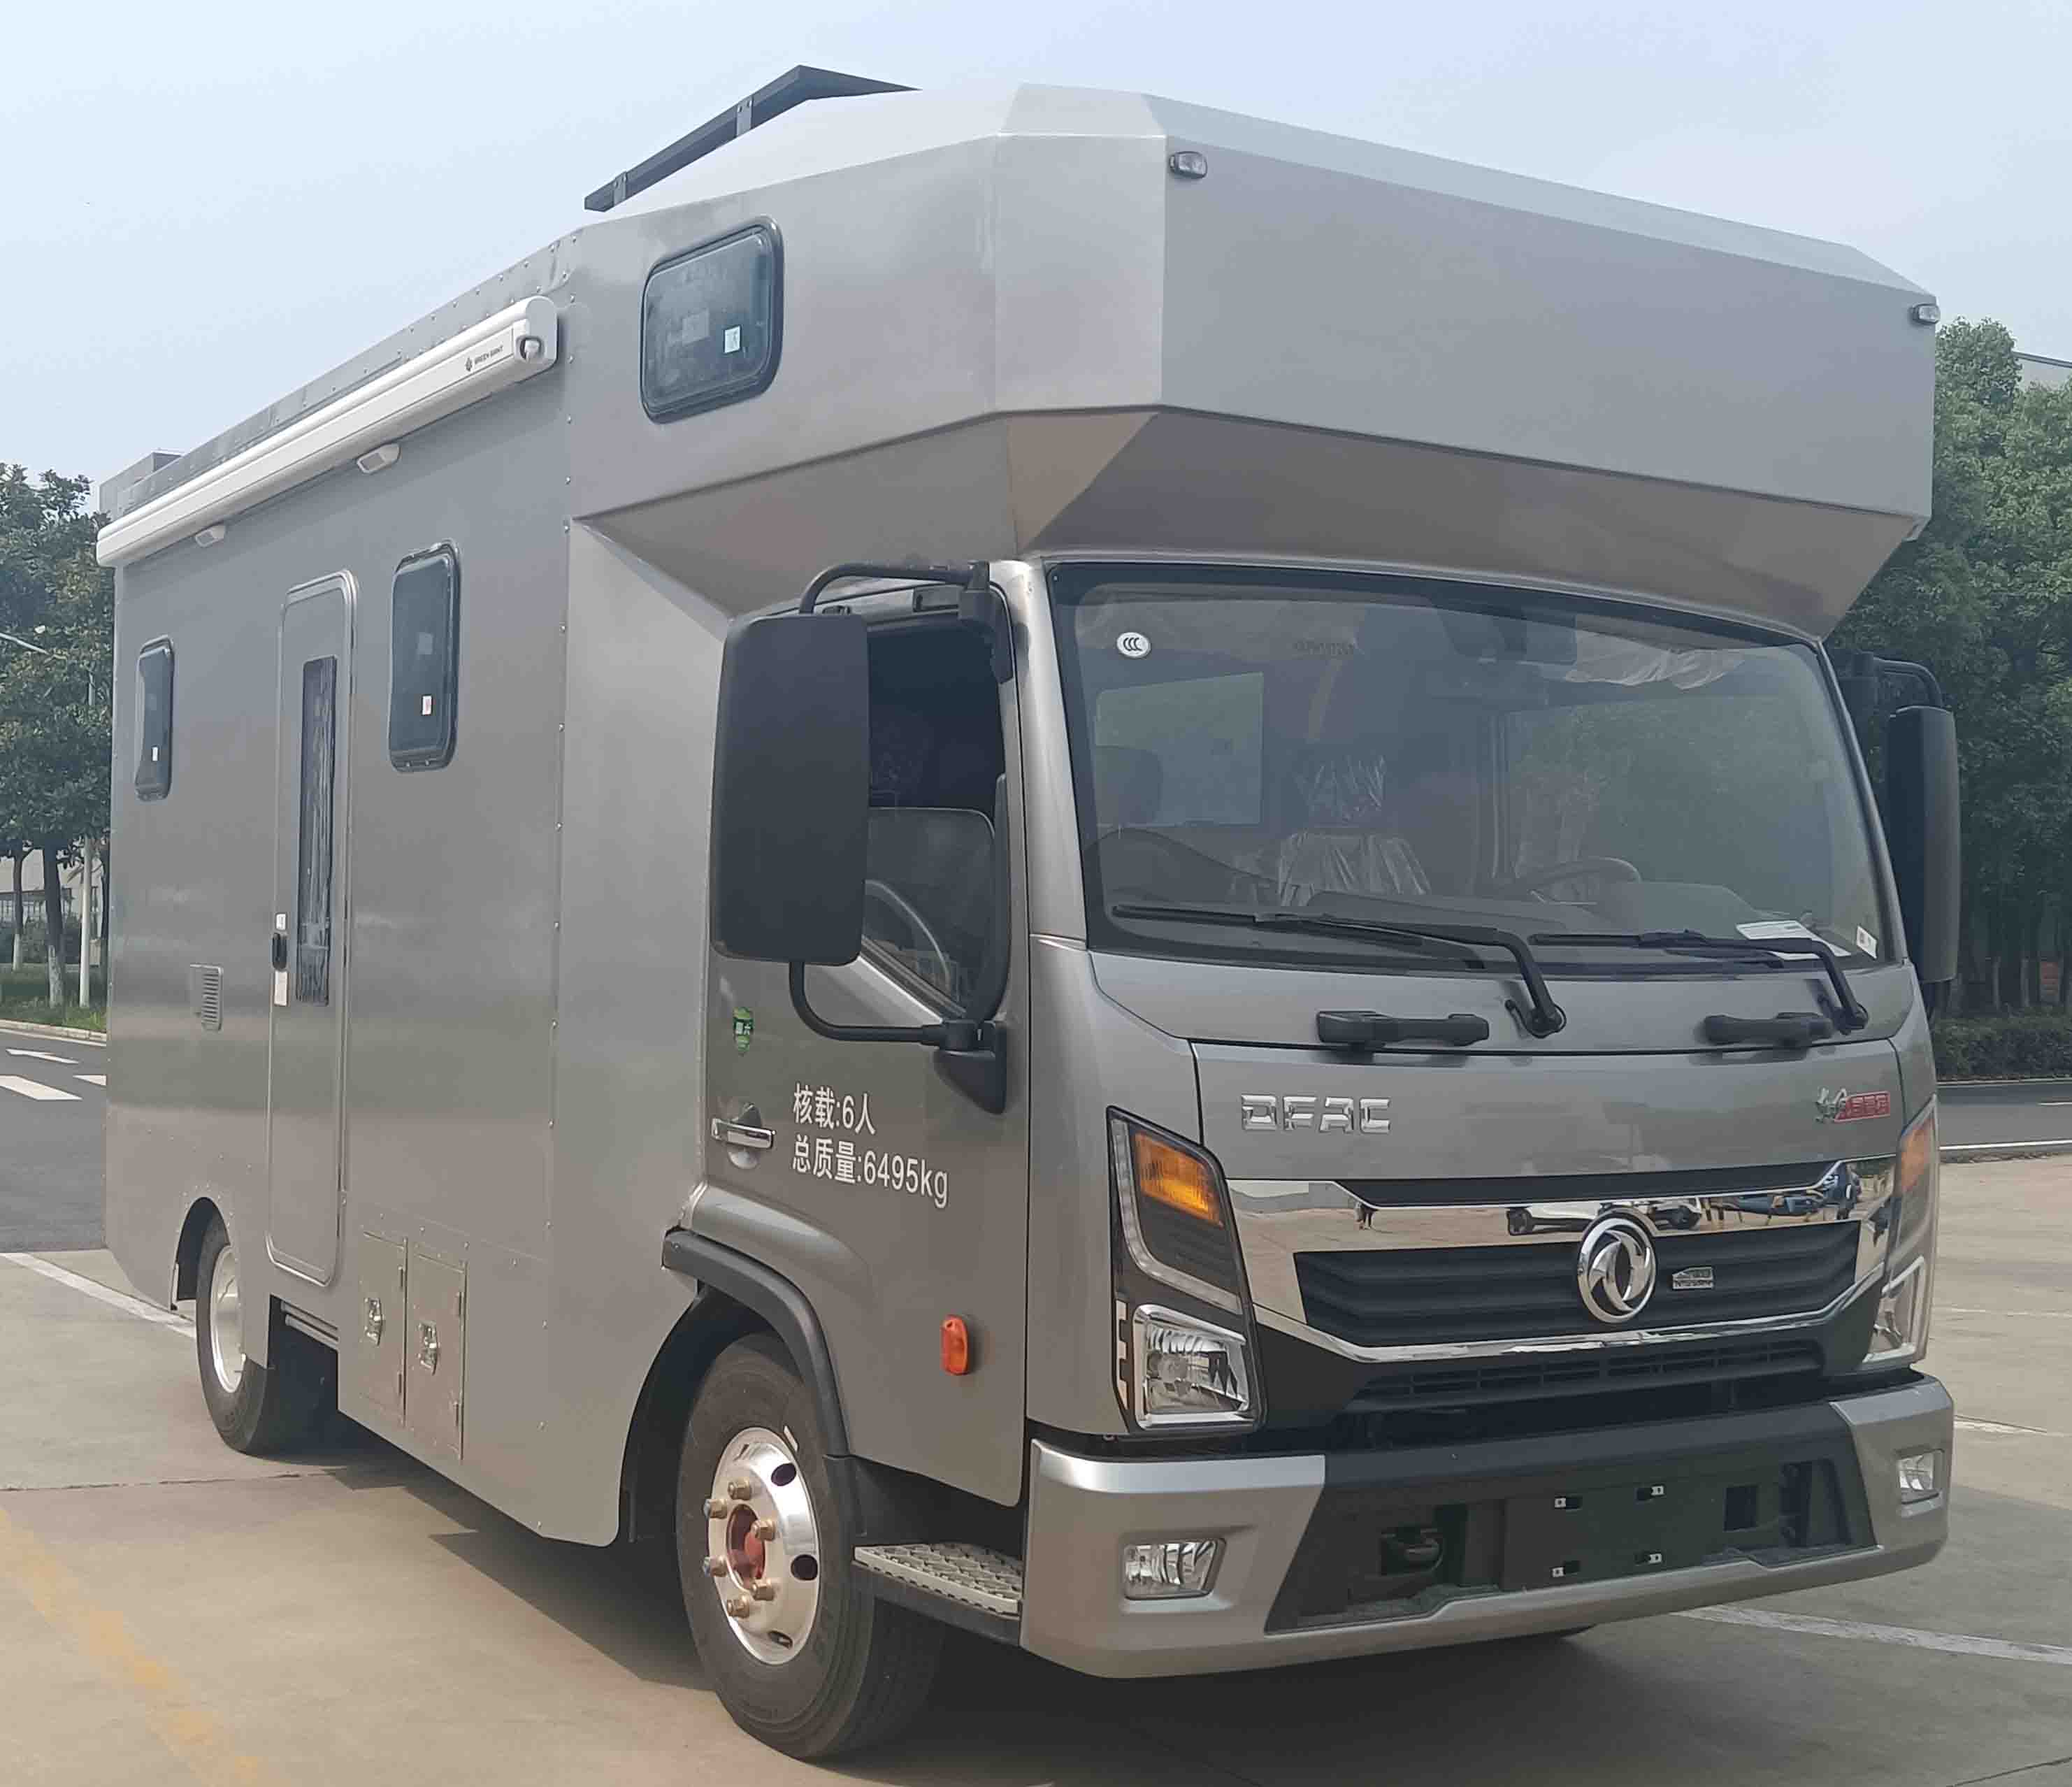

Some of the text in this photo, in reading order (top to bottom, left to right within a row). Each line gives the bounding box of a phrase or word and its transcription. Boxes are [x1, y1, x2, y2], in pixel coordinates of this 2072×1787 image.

[793, 1082, 876, 1135] 核载:6人
[1241, 1094, 1390, 1133] DFAC
[792, 1133, 948, 1209] 总质量:6495kg
